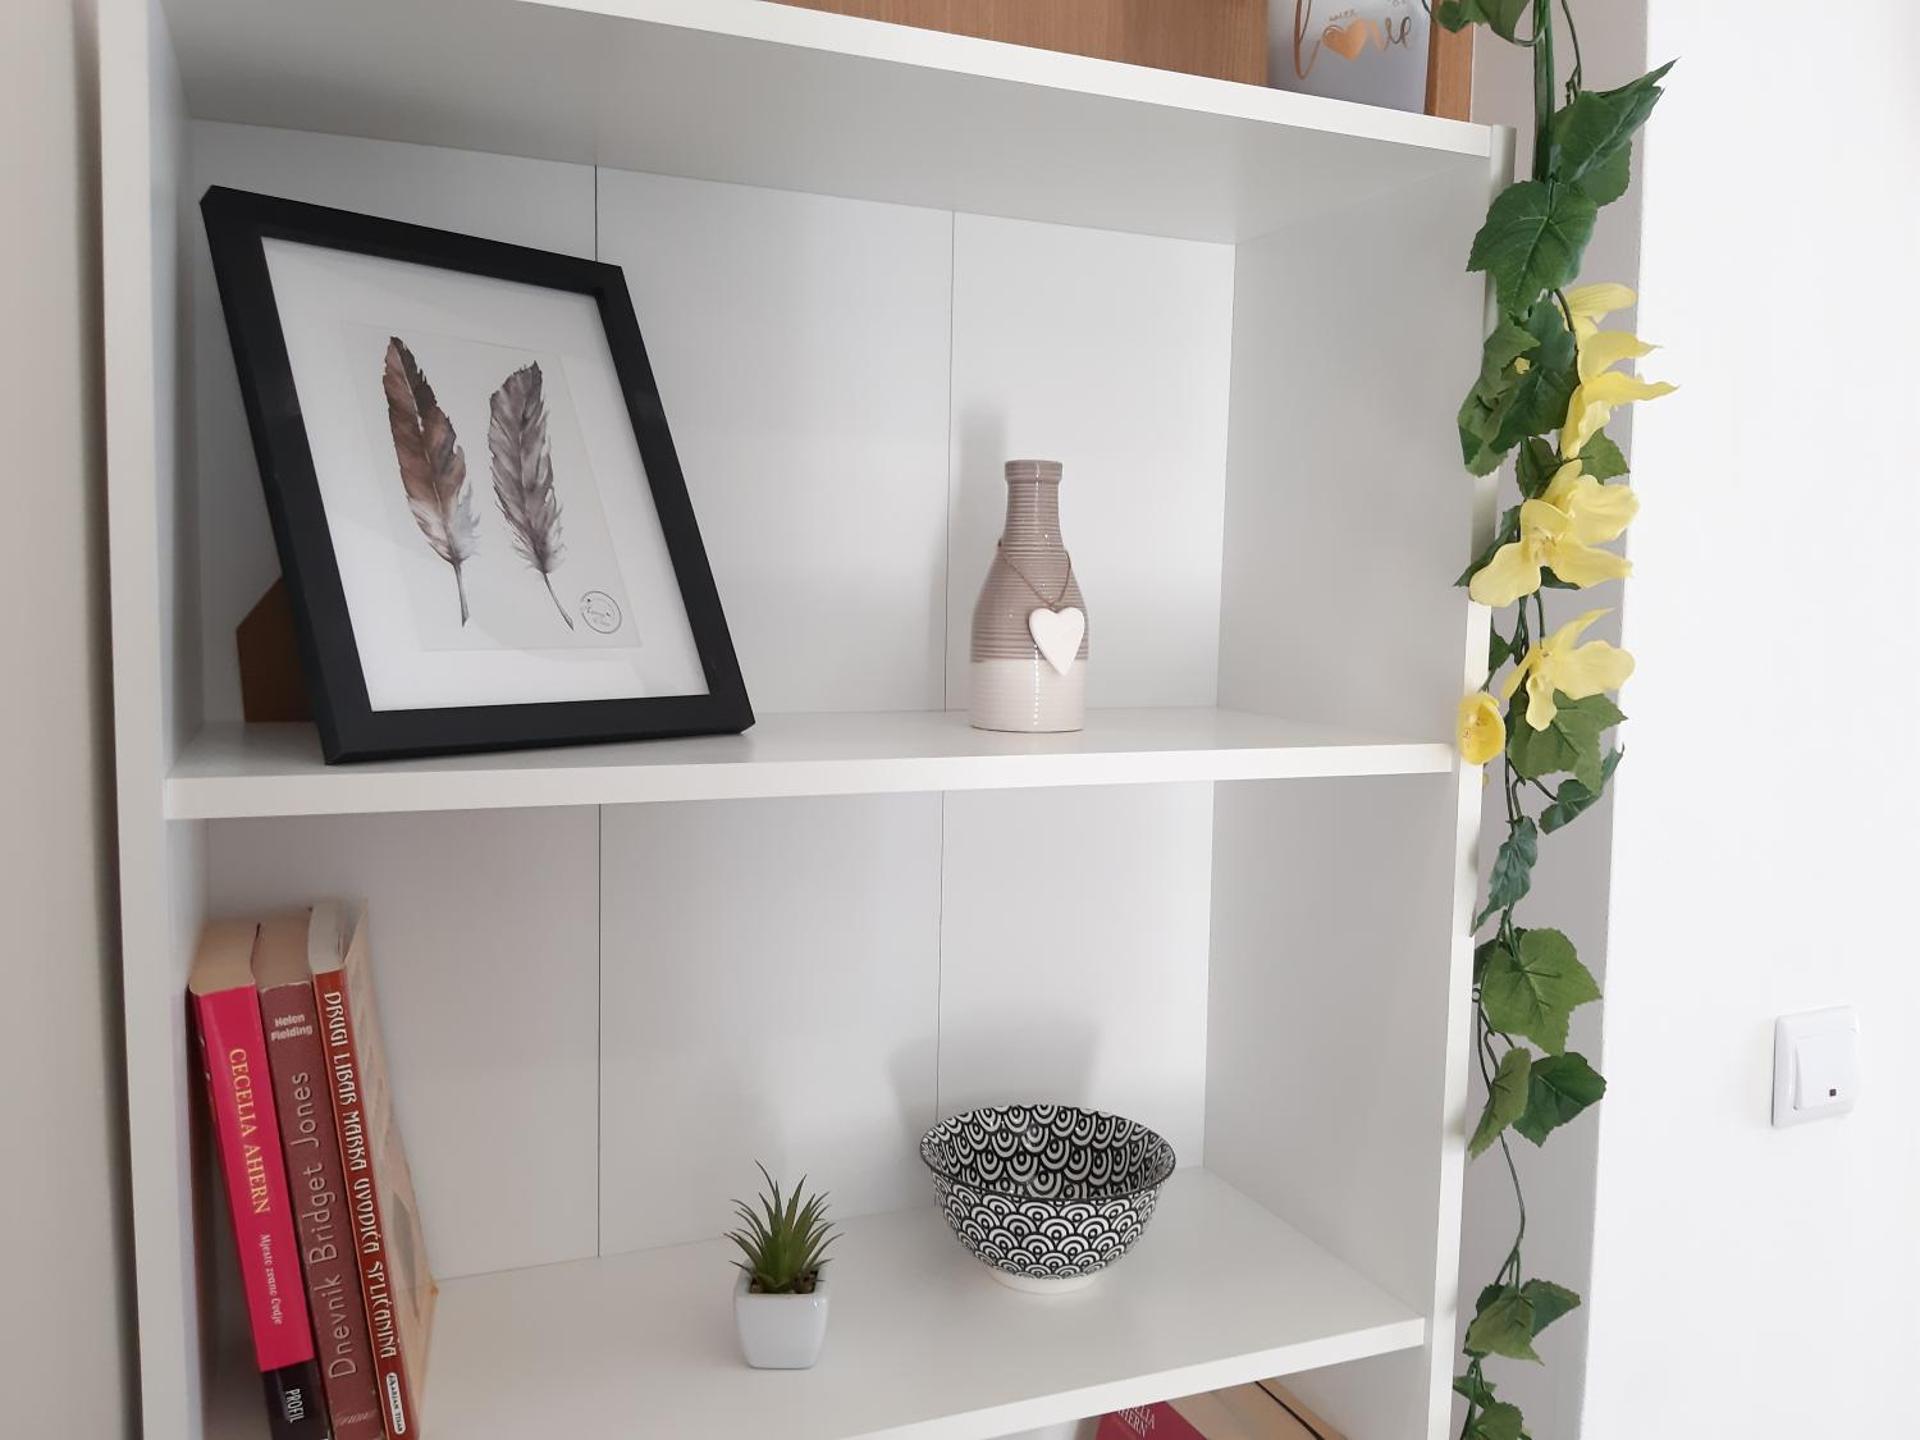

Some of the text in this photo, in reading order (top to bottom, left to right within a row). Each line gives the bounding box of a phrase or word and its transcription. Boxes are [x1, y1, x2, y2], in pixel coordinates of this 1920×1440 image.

[270, 1025, 313, 1041] Fielding
[274, 1013, 305, 1027] Helen
[324, 991, 349, 1046] DRUGI
[333, 1053, 357, 1106] LIBAR
[229, 1048, 272, 1214] CECELIA AHERN
[290, 1072, 319, 1148] Jones
[343, 1111, 367, 1171] MARKA
[302, 1162, 337, 1264] Bridget
[354, 1178, 382, 1254] UVODIĆA
[313, 1274, 357, 1379] Dnevnik
[285, 1388, 305, 1424] PROFIL
